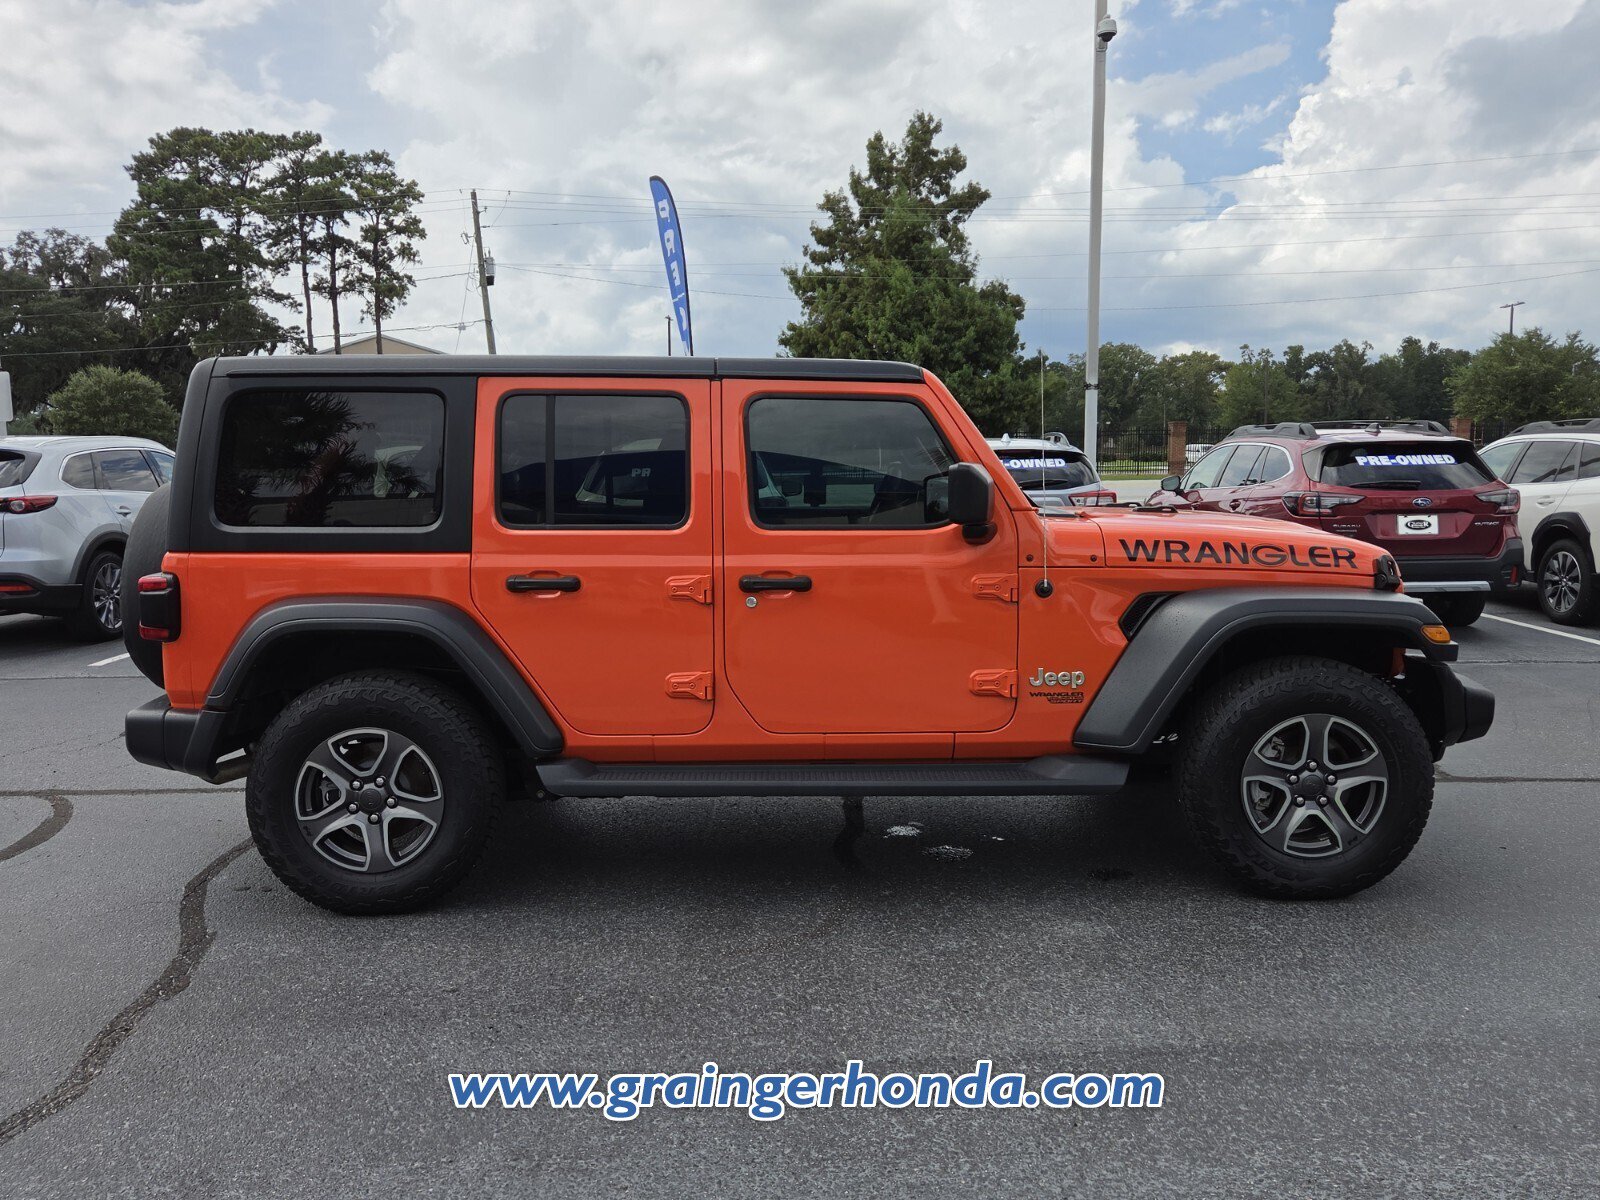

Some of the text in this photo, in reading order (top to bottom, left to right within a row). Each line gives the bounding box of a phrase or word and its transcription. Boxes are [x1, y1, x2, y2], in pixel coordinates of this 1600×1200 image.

[1355, 454, 1456, 466] PRE-OWNED
[1119, 538, 1359, 569] WRANGLER
[1029, 667, 1085, 689] Jeep
